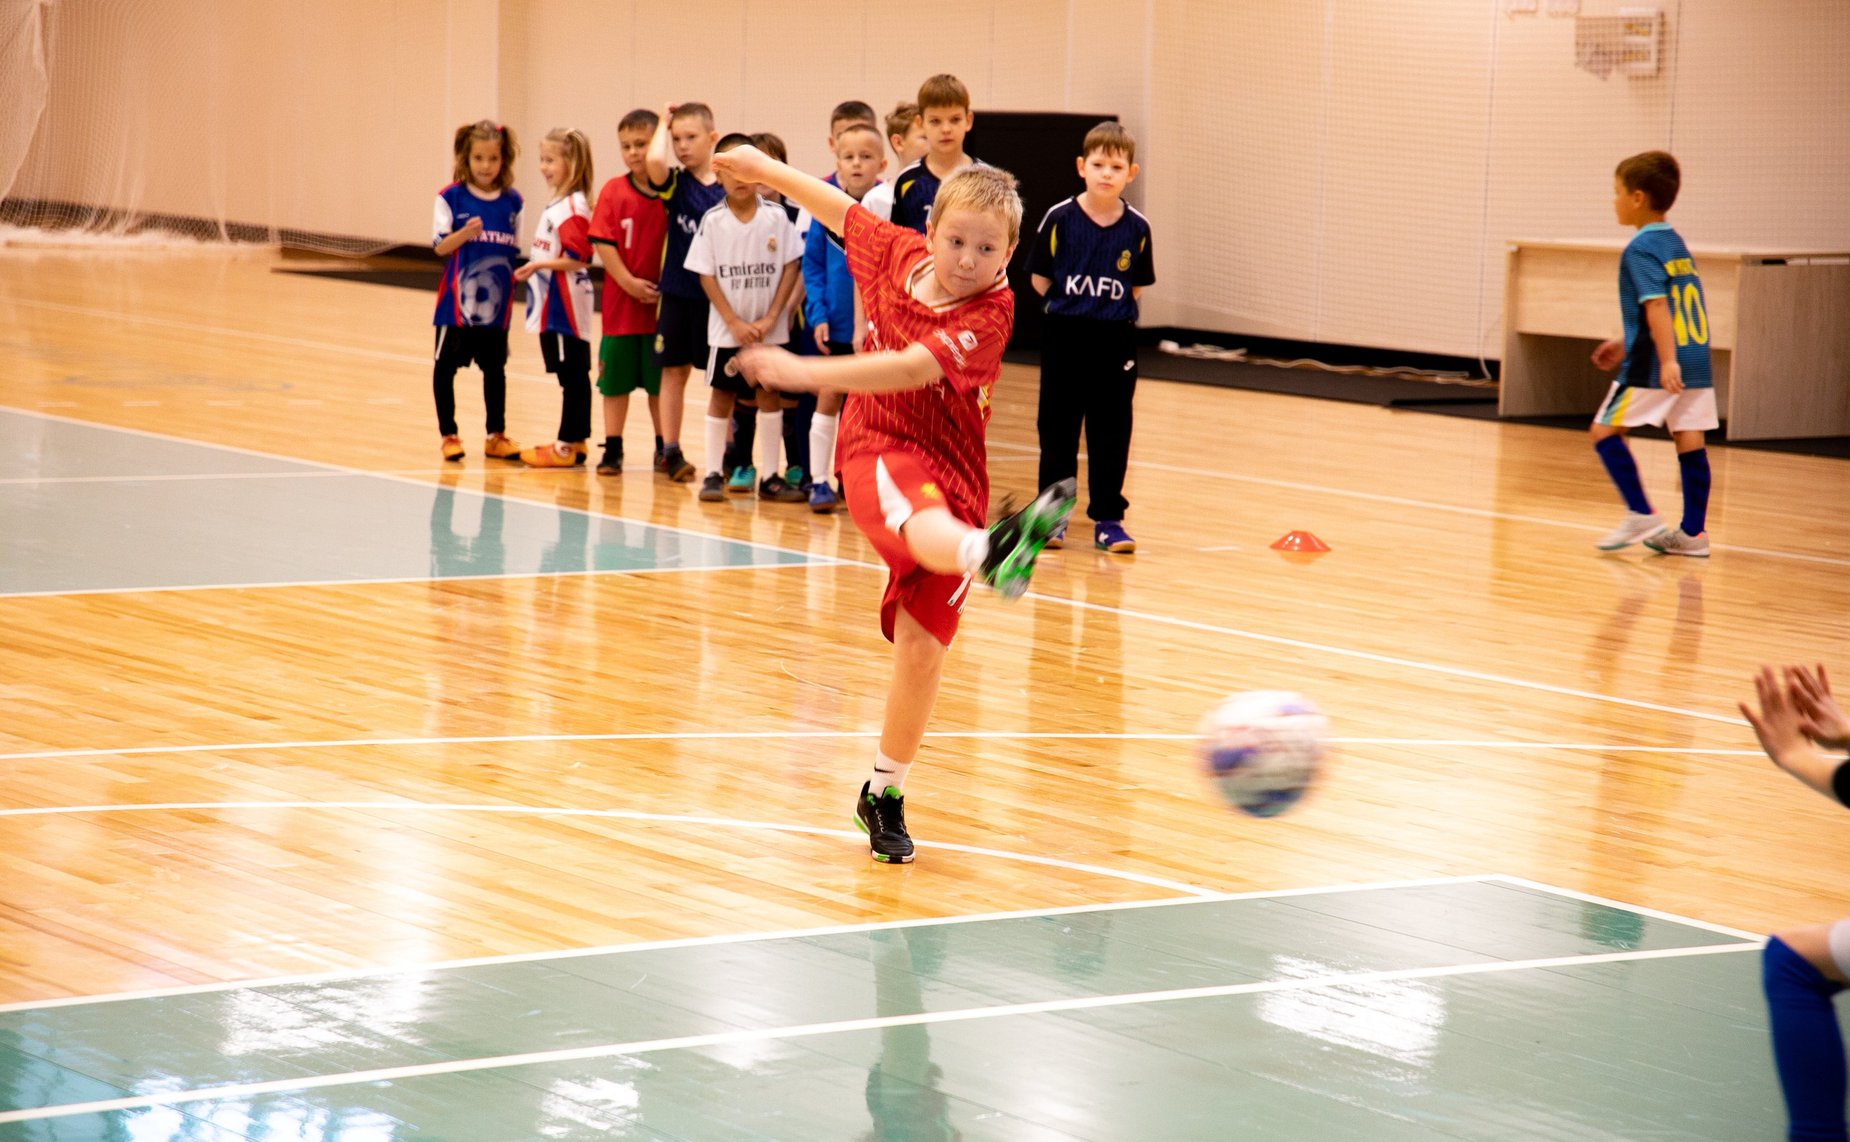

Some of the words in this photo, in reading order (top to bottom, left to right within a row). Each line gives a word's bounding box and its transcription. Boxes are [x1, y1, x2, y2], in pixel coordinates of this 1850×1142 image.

[719, 261, 777, 279] Emirates
[1065, 275, 1125, 301] KAFD
[1670, 282, 1708, 346] 10
